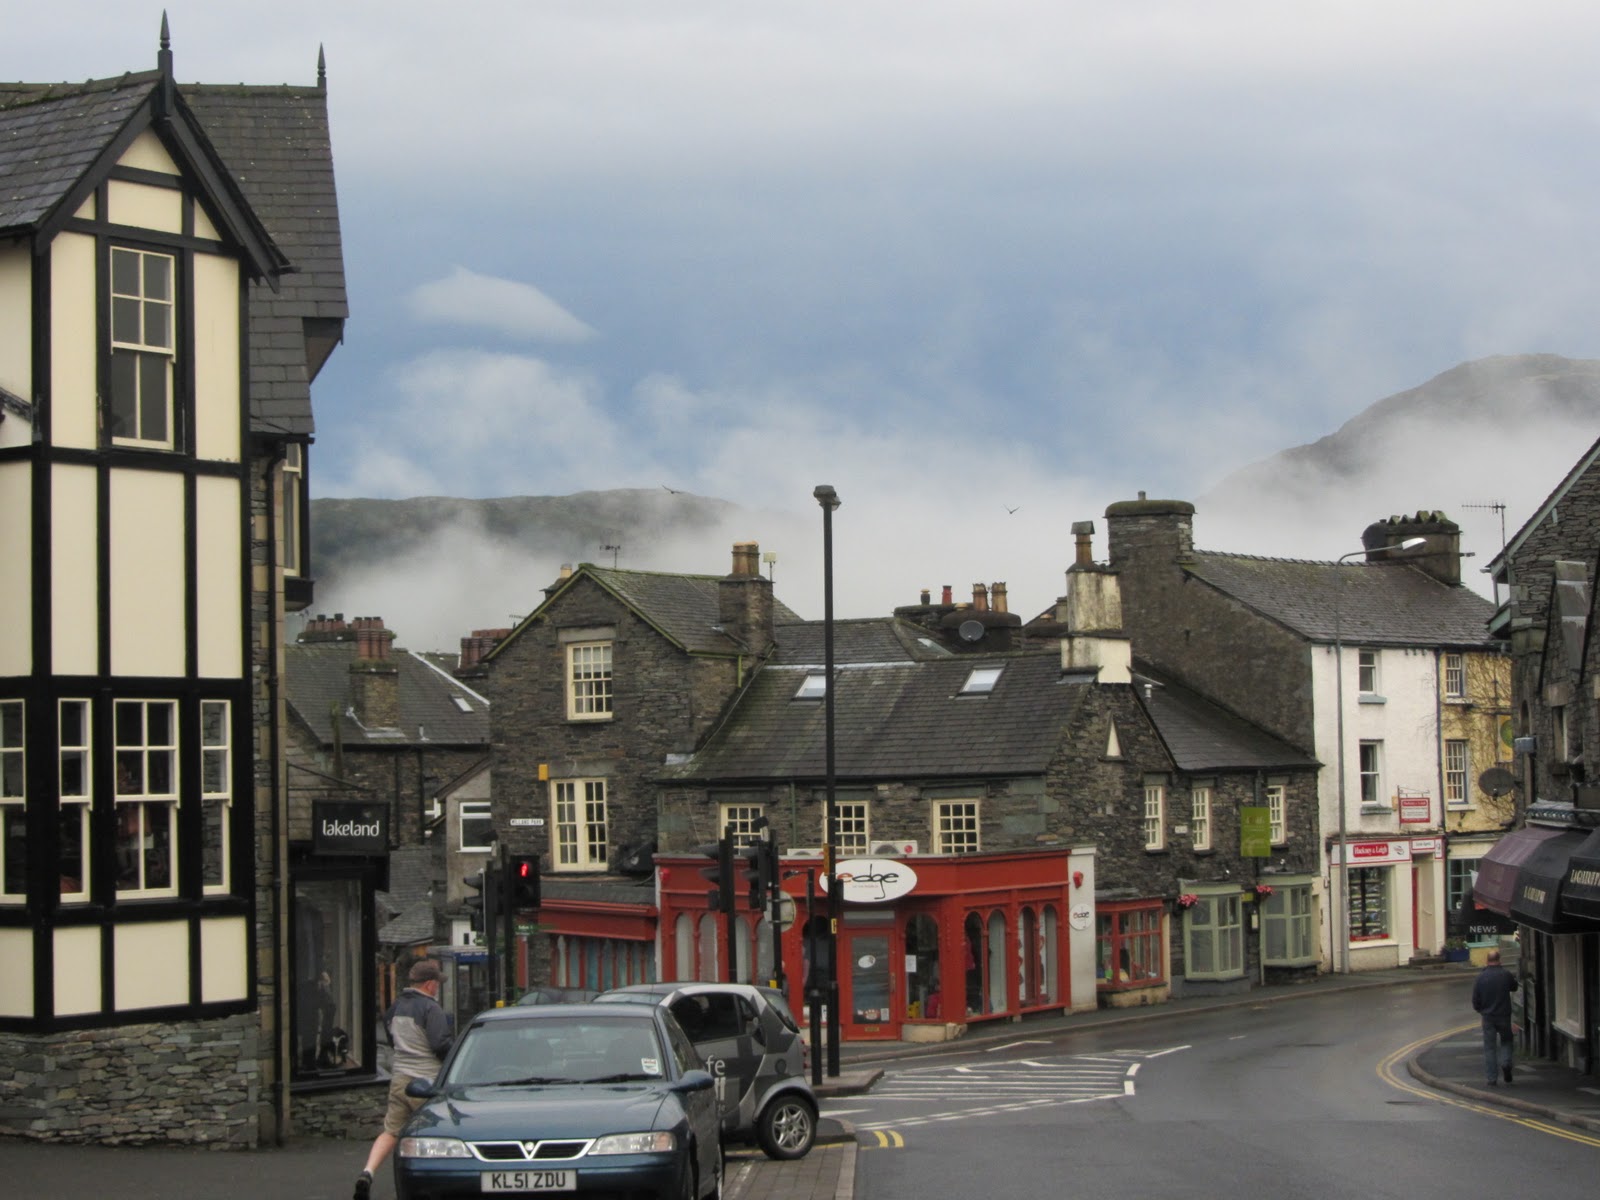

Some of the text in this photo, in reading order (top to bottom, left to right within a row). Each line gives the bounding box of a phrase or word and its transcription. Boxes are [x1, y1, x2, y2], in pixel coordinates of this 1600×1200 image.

[322, 819, 380, 836] lakeland
[1354, 846, 1372, 856] Hackney
[1375, 845, 1388, 855] Leigh
[837, 863, 899, 900] edge
[1469, 925, 1497, 933] NEWS
[491, 1171, 566, 1189] KL51 ZDU
